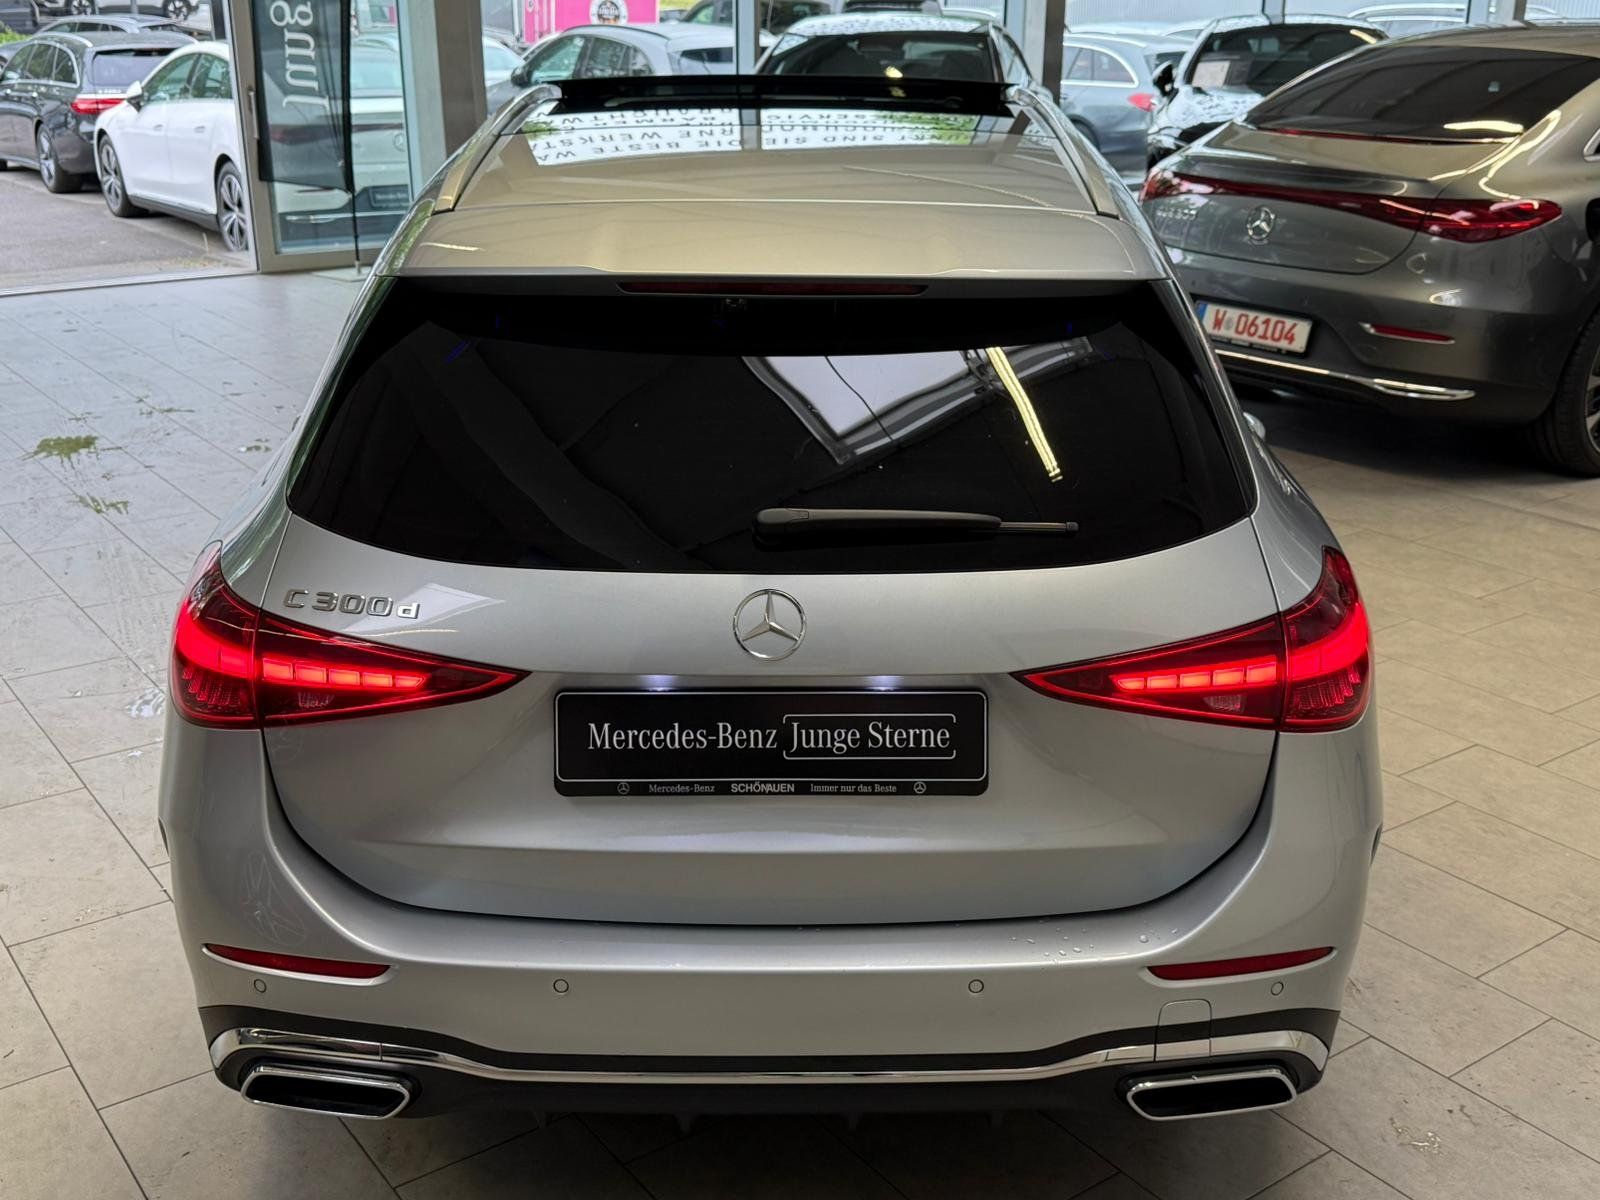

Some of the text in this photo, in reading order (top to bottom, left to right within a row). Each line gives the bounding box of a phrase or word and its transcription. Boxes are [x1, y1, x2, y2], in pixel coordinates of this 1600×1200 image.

[1212, 309, 1298, 345] W 06104
[588, 721, 951, 754] Mercedes-Benz Junge Sterne
[648, 783, 715, 793] Mercedes-Benz
[810, 783, 838, 793] Immer
[840, 785, 855, 793] nur
[857, 783, 872, 793] das
[874, 783, 897, 793] Beste
